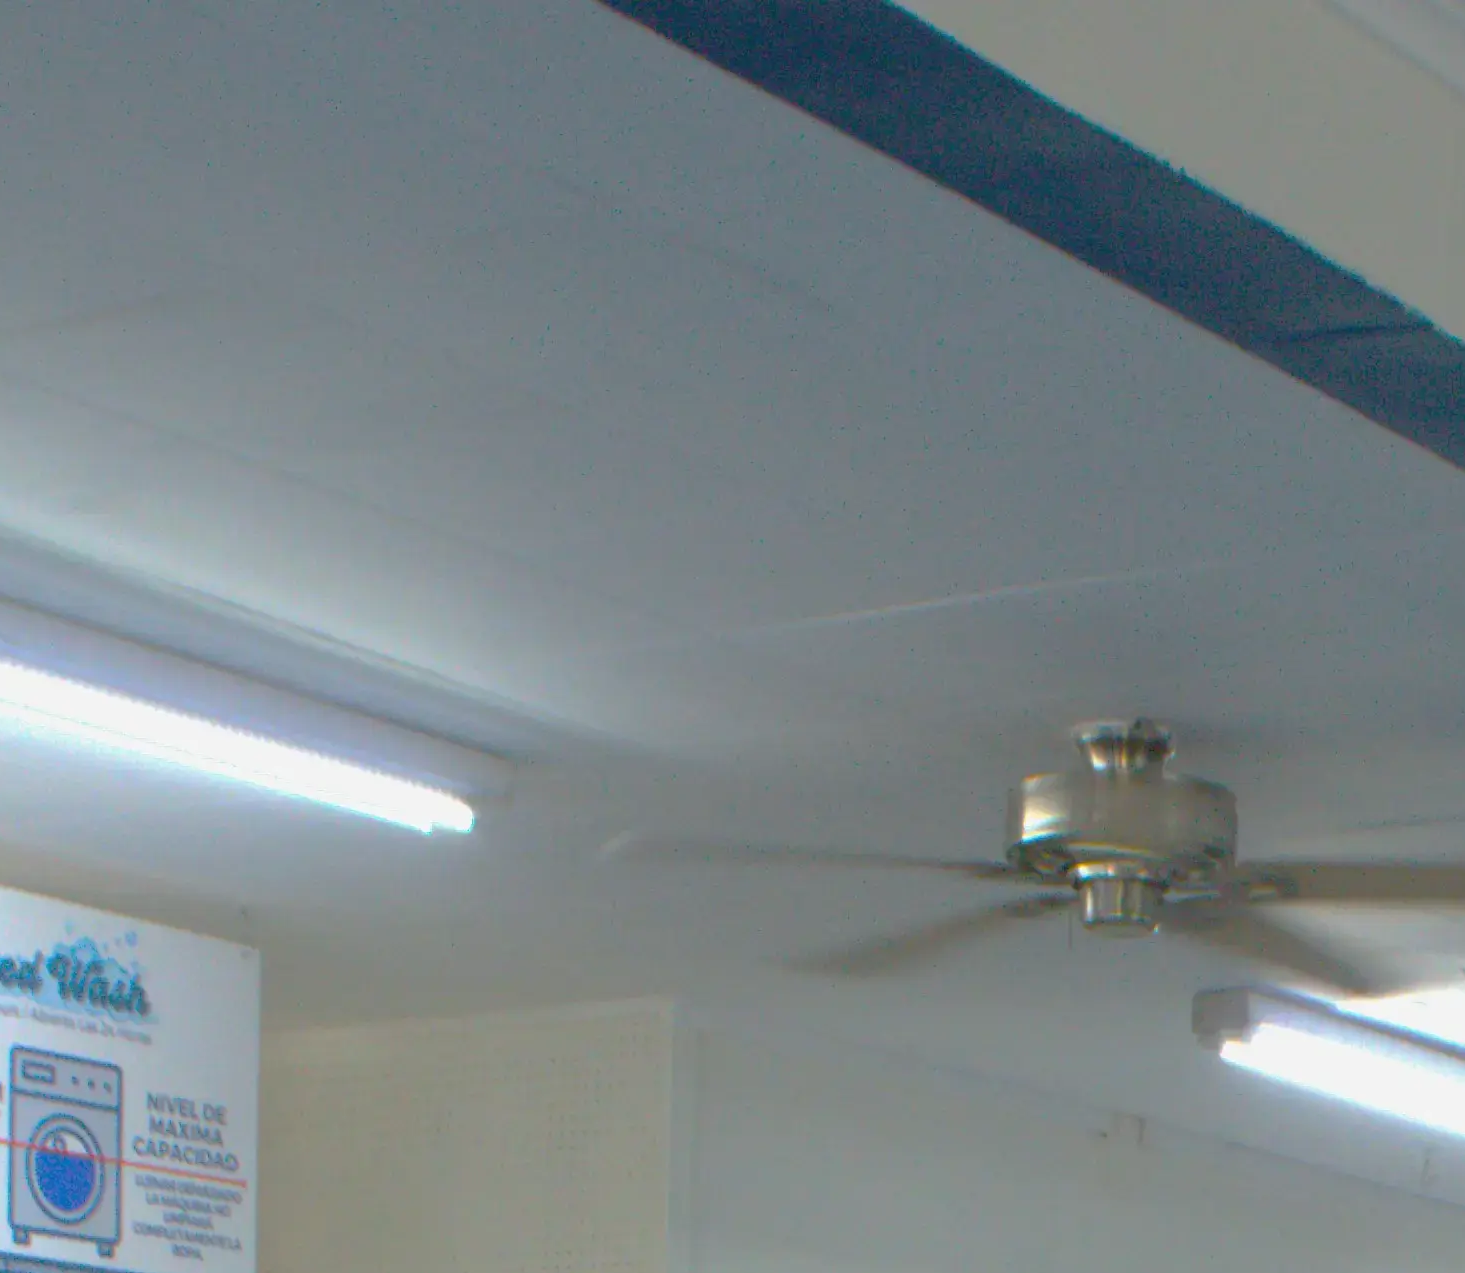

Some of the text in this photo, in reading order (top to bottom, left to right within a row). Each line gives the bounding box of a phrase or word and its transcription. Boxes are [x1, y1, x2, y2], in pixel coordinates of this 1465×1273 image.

[45, 950, 151, 1017] Wash
[147, 1092, 228, 1126] NIVEL DE
[133, 1136, 239, 1172] CAPACIDAD
